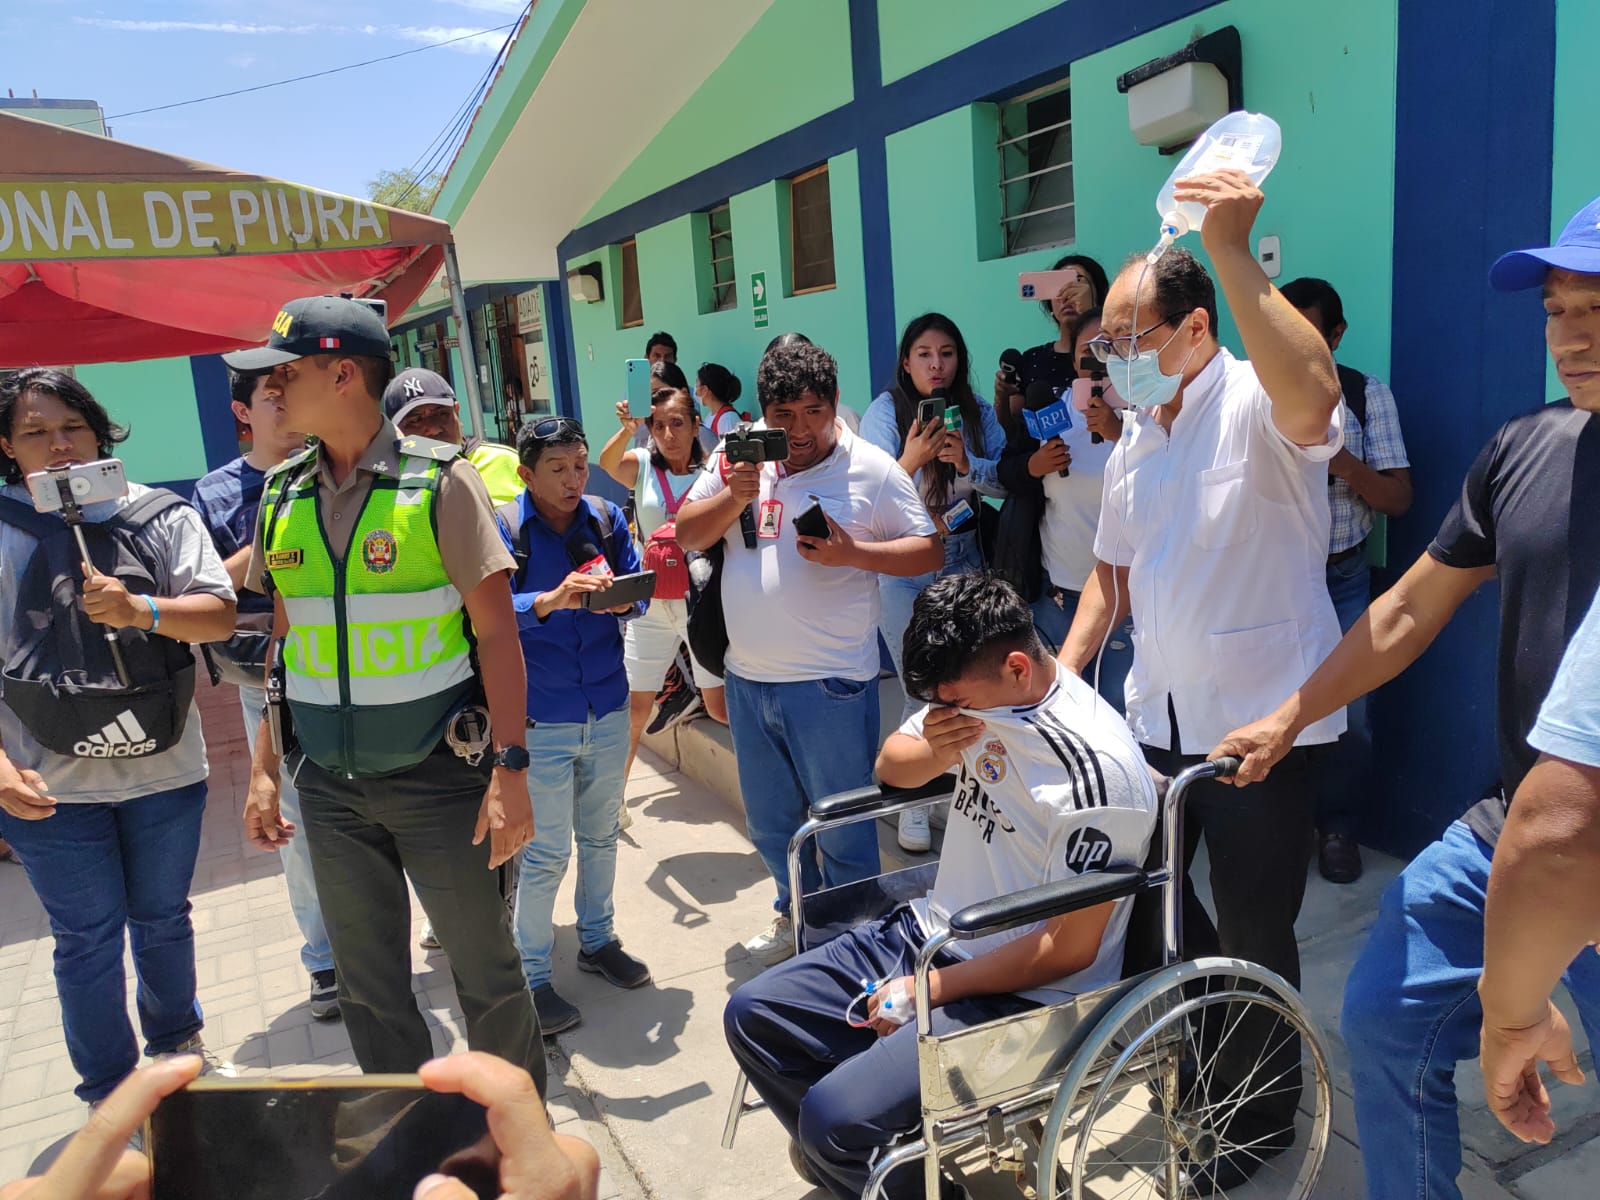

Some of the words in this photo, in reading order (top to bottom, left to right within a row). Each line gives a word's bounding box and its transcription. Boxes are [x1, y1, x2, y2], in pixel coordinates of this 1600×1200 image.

[143, 190, 220, 248] DE
[229, 188, 383, 246] PIURA
[1040, 409, 1066, 429] RPI
[73, 739, 157, 758] adidas
[1068, 828, 1109, 872] hp
